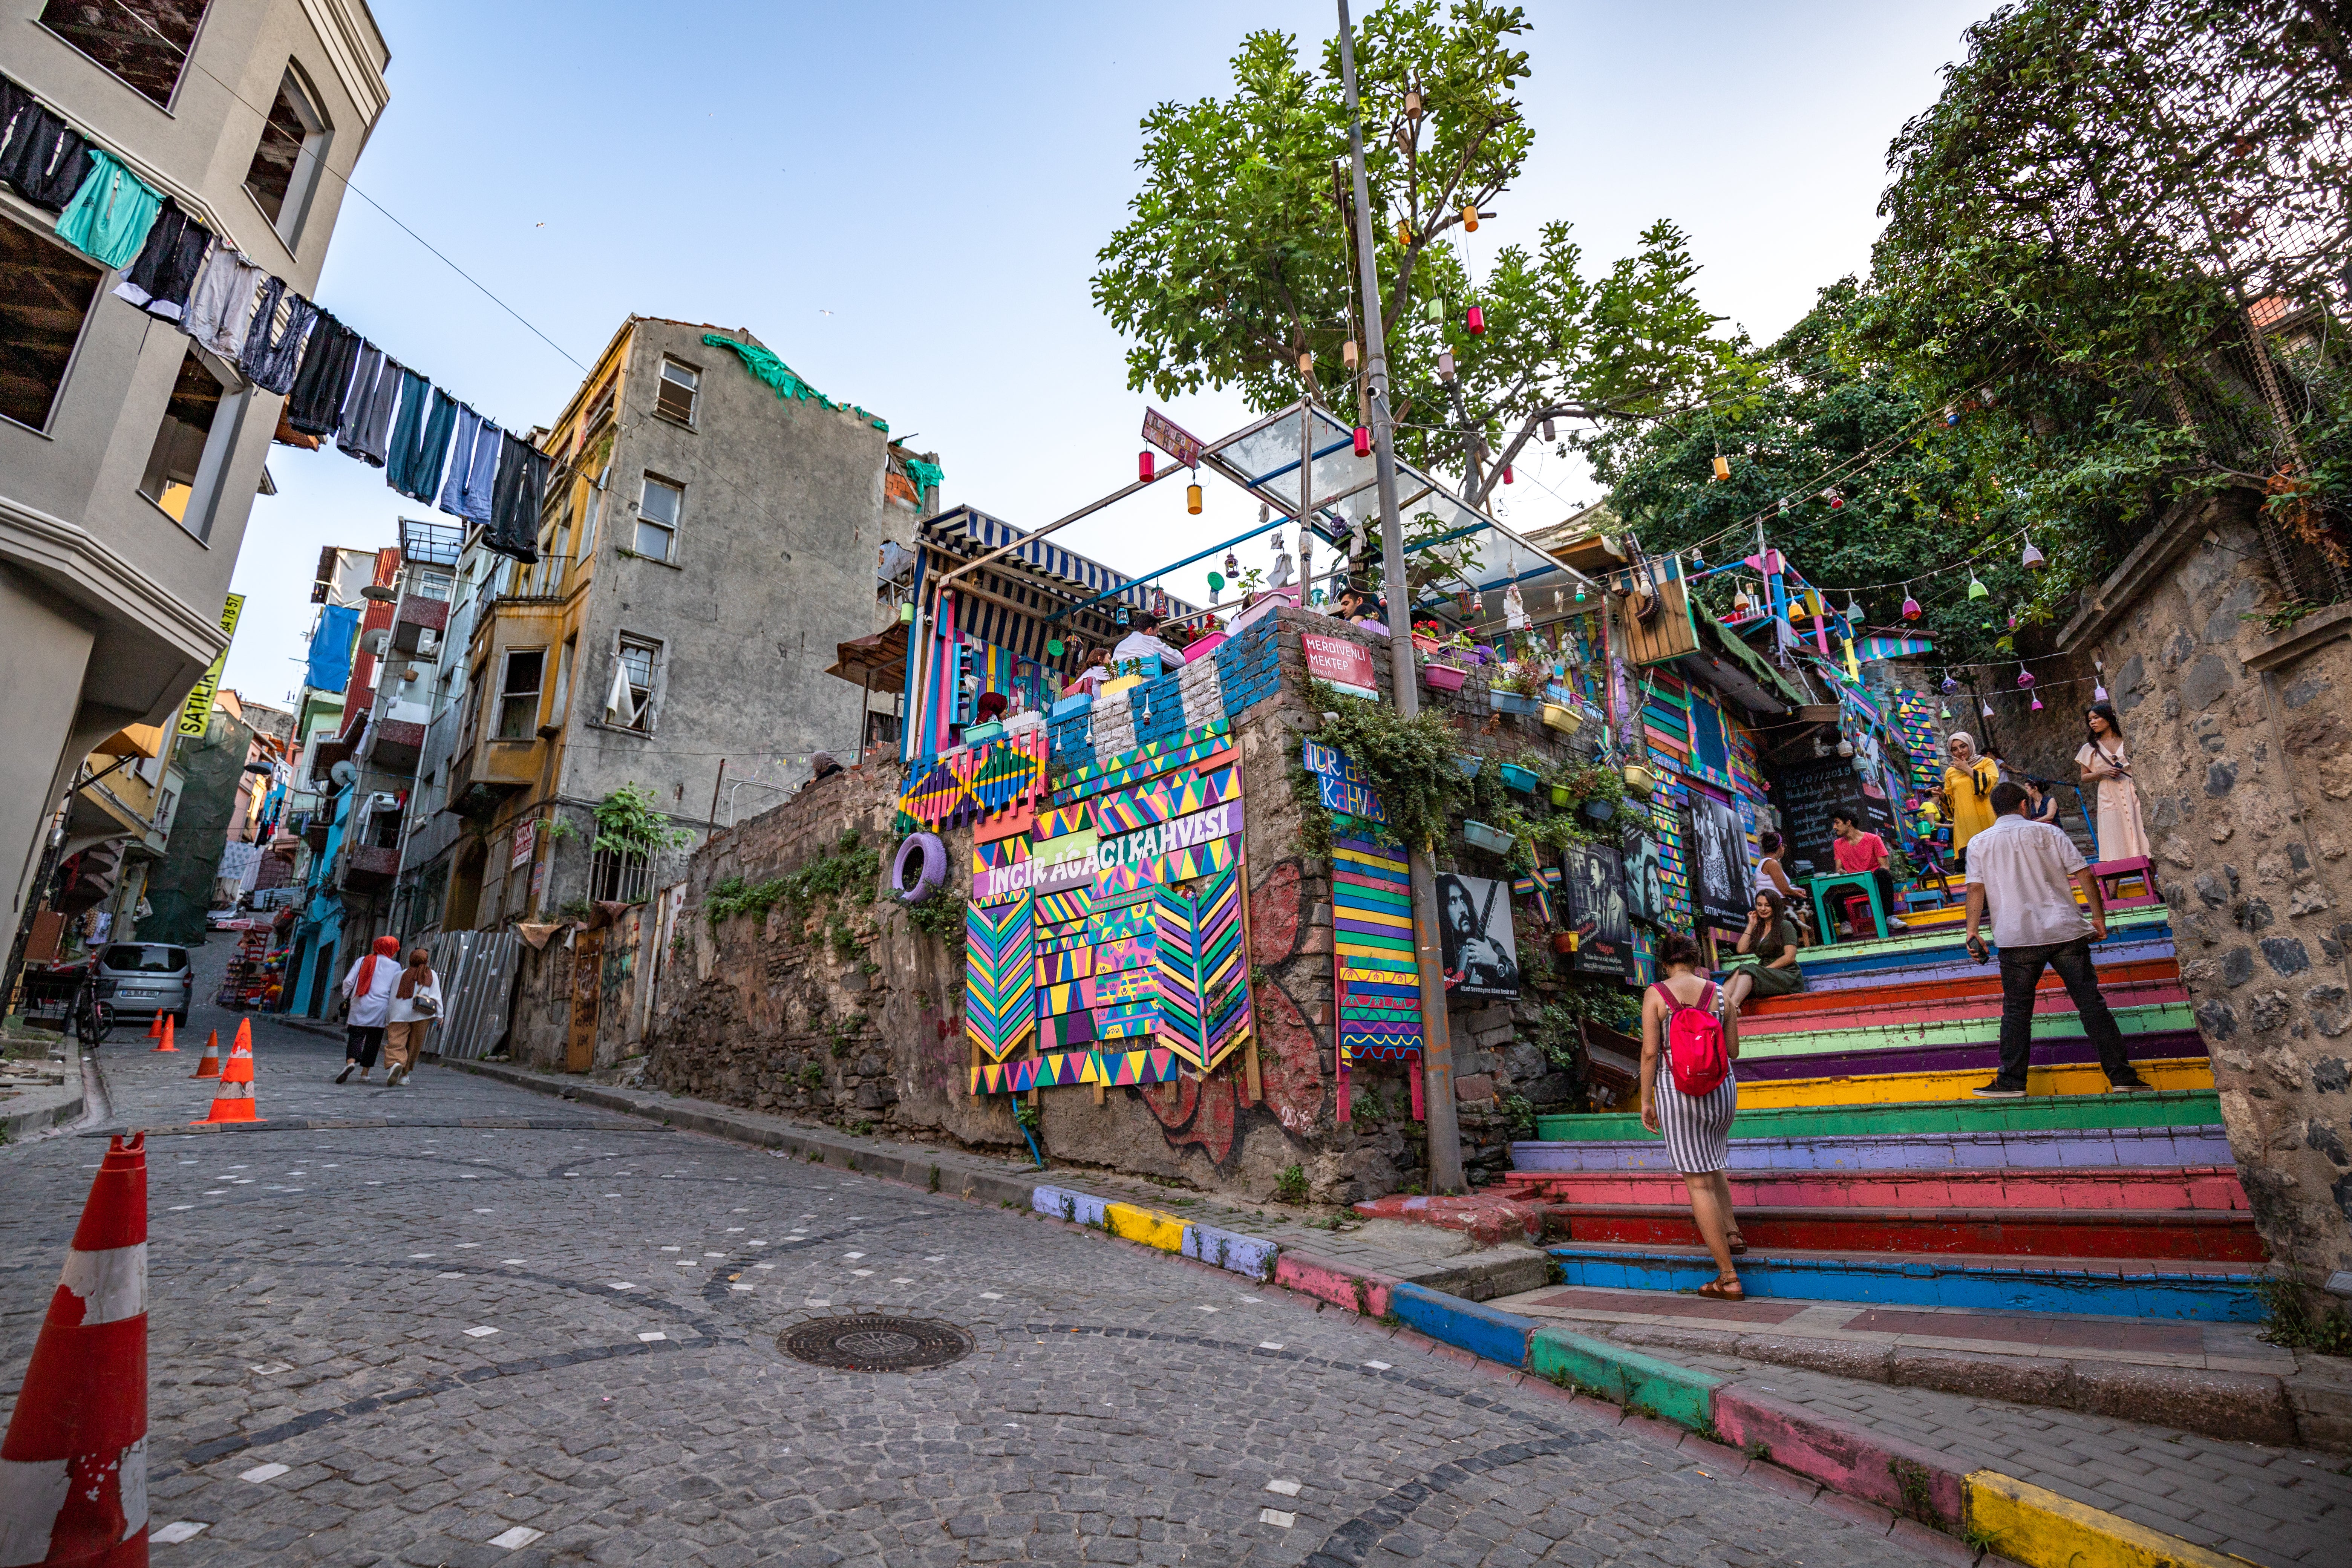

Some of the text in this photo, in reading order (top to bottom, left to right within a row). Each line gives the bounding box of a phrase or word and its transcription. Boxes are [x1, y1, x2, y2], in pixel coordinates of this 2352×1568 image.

[1306, 638, 1366, 661] MERDİVENLİ
[1309, 654, 1349, 671] MEKTEP
[1311, 668, 1334, 678] SOKAĞI
[180, 674, 216, 733] SATILIK
[1704, 905, 1718, 916] GİTTİN
